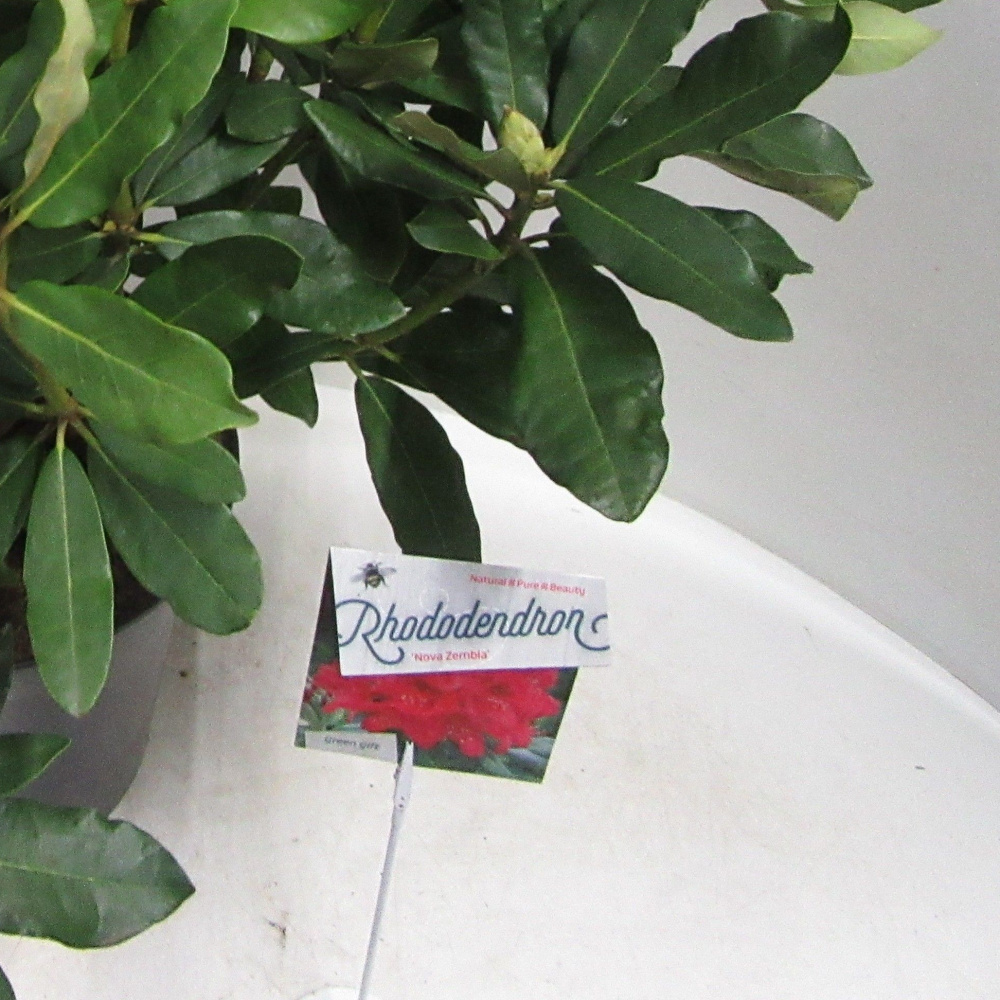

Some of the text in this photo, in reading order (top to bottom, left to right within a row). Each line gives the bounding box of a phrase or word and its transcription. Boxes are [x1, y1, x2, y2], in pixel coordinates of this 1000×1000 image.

[470, 573, 586, 596] Natural Pure Beauty
[334, 597, 611, 665] Rhododendron
[324, 735, 357, 747] Green
